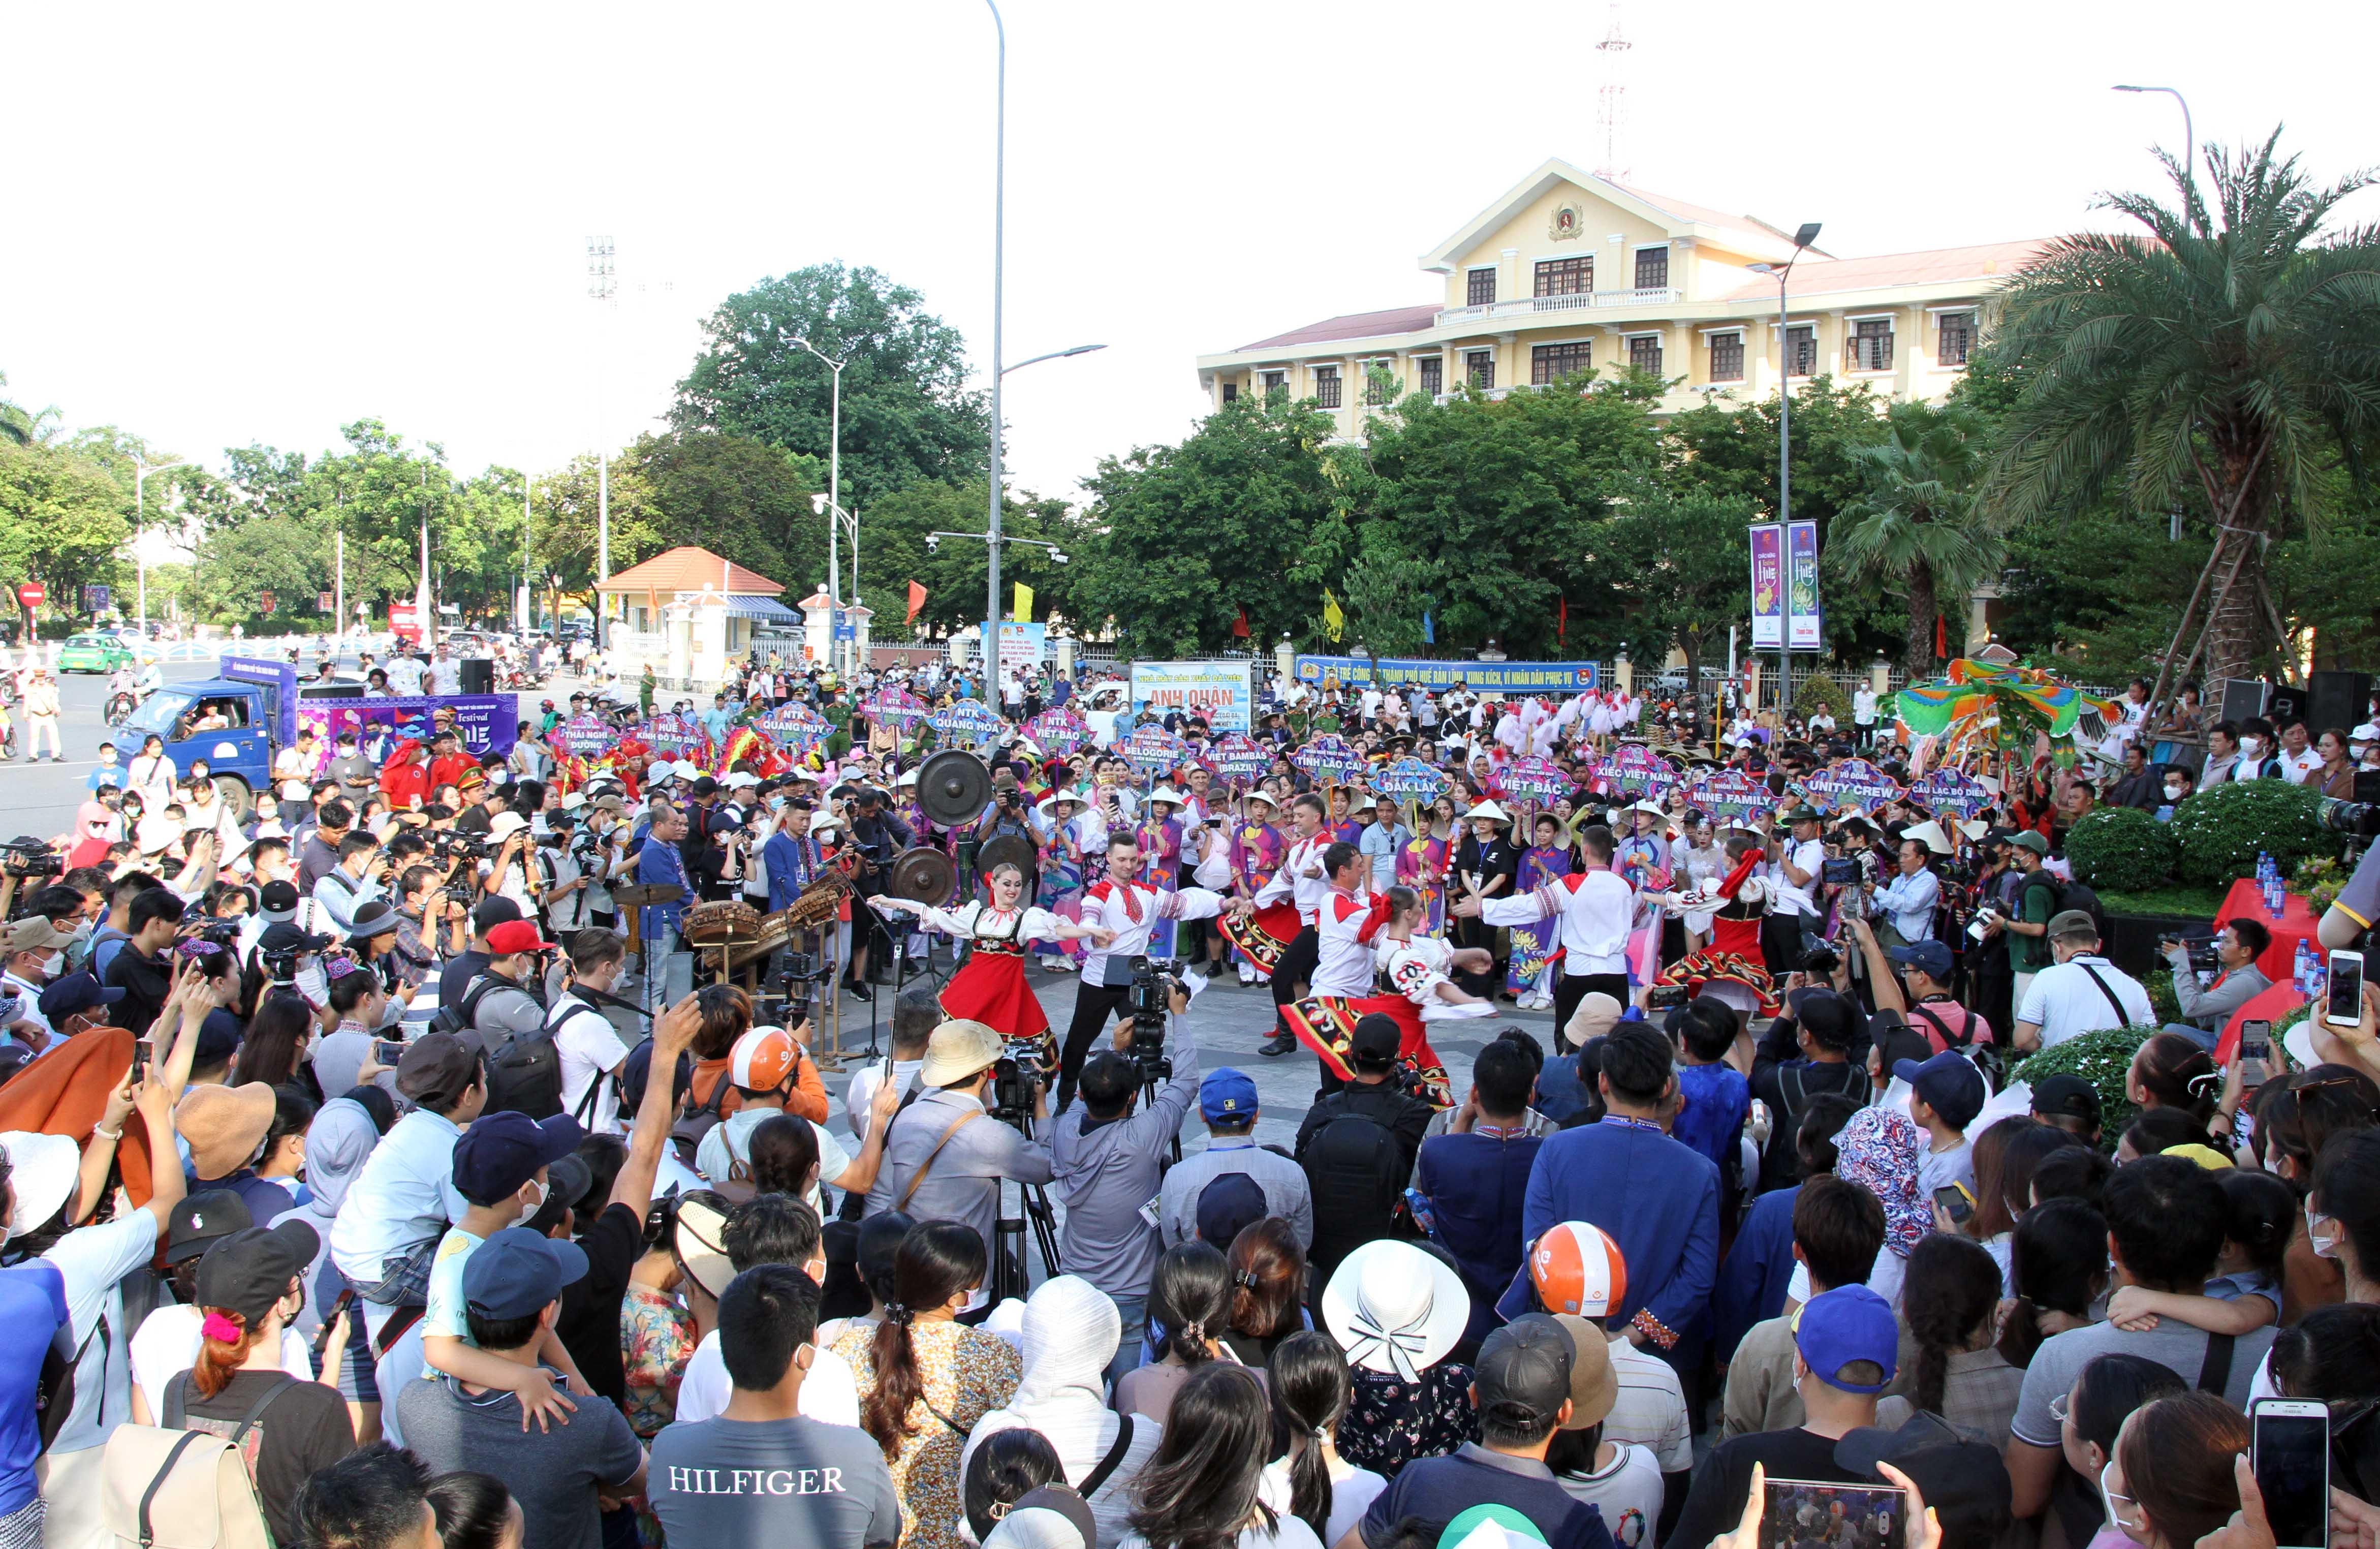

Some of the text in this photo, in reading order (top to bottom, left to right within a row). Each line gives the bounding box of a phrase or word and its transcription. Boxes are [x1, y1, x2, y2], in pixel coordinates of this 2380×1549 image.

[1353, 665, 1370, 681] CÔNG
[1384, 667, 1403, 683] THÀNH
[1405, 665, 1418, 683] PHỐ
[1419, 666, 1432, 684] HUẾ
[1433, 666, 1447, 684] BẢN
[1466, 671, 1484, 685] XUNG
[1485, 669, 1502, 687] KÍCH,
[1512, 669, 1529, 685] NHÂN
[1530, 669, 1544, 685] DÂN
[1545, 671, 1562, 688] PHỤC
[1563, 671, 1573, 688] VỤ
[1150, 689, 1183, 707] ANH
[784, 709, 805, 720] NTK
[957, 707, 979, 718] NTK
[659, 722, 679, 733] HUẾ
[763, 720, 825, 734] QUANG HUY
[936, 718, 974, 730] QUANG
[1048, 717, 1068, 727] NTK
[565, 729, 585, 739] THÁI
[636, 732, 656, 740] KINH
[1035, 726, 1056, 738] VIẾT
[1124, 746, 1179, 759] BELOGORIE
[1229, 752, 1267, 761] BAMBAS
[1220, 763, 1257, 773] (BRAZIL)
[1323, 757, 1343, 769] LÀO
[1346, 761, 1362, 771] CAI
[1598, 765, 1673, 783] XIẾC VIỆT NAM
[1385, 776, 1438, 793] ĐẮK LẮK
[1499, 777, 1562, 795] VIỆT BẮC
[1809, 780, 1894, 798] UNITY CREW
[1912, 786, 1930, 794] CÂU
[1932, 787, 1949, 797] LẠC
[1693, 791, 1771, 806] NINE FAMILY
[1932, 796, 1967, 807] (TP HUẾ)
[668, 1465, 847, 1495] HILFIGER
